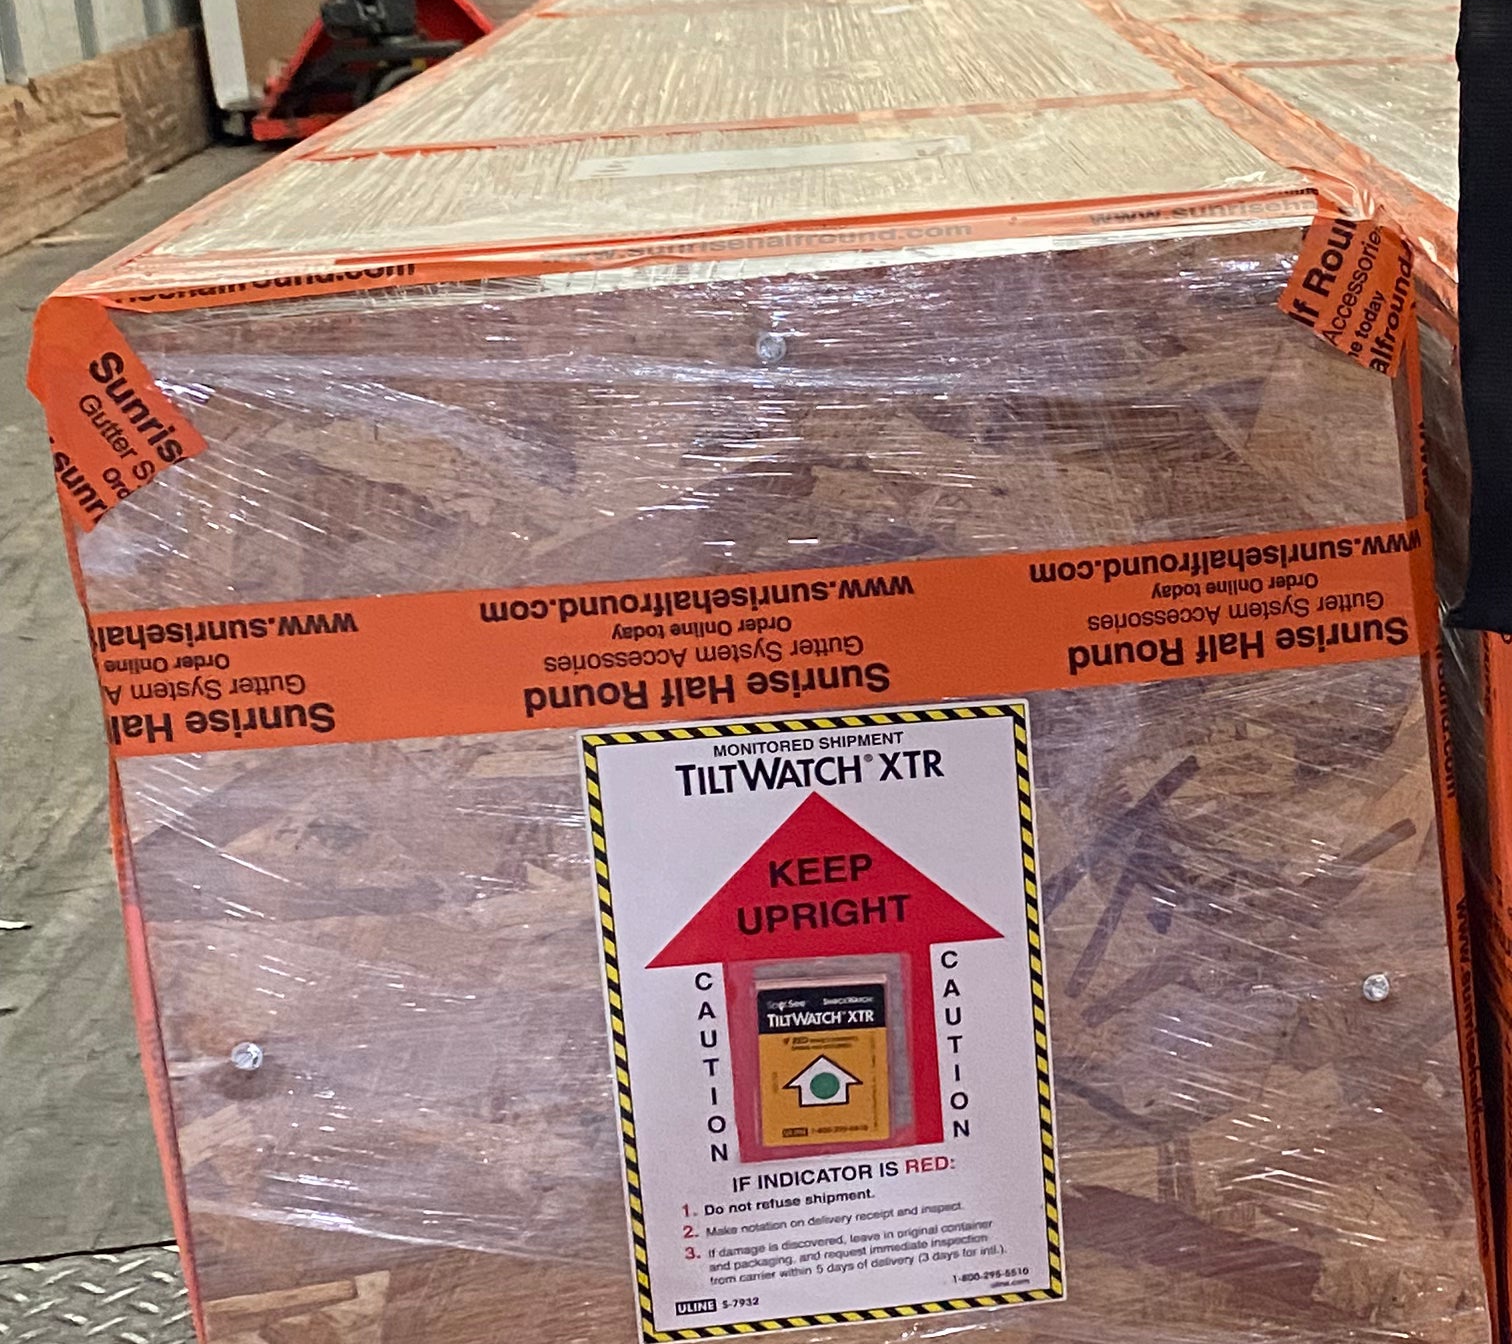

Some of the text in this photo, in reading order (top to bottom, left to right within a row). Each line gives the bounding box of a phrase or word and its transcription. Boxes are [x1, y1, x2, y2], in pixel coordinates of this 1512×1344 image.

[88, 350, 188, 465] Sunris
[1030, 529, 1421, 583] www.sunrisehalfround.com
[480, 576, 914, 623] www.sunrisehalfround.com
[1152, 573, 1318, 600] Order Online today
[612, 616, 791, 641] Order Online today
[1088, 591, 1383, 633] Gutter System Accessories
[104, 654, 229, 674] Order Online
[544, 636, 863, 675] Gutter System Accessories
[1068, 617, 1408, 675] Sunrise Half Round
[131, 674, 305, 701] Gutter System
[524, 663, 889, 718] Sunrise Half Round
[107, 703, 335, 745] Sunrise Hal
[714, 731, 903, 757] MONITORED SHIPMENT
[880, 749, 944, 781] XTR
[769, 854, 872, 888] KEEP
[738, 895, 910, 935] UPRIGHT
[848, 1010, 874, 1022] XTR
[941, 950, 970, 1137] CAUTION
[695, 972, 728, 1161] CAUTION
[733, 1157, 954, 1192] IF INDICATOR IS RED:
[682, 1188, 875, 1217] 1. Do not refuse shipment.
[677, 1297, 759, 1314] ULINE S-7932
